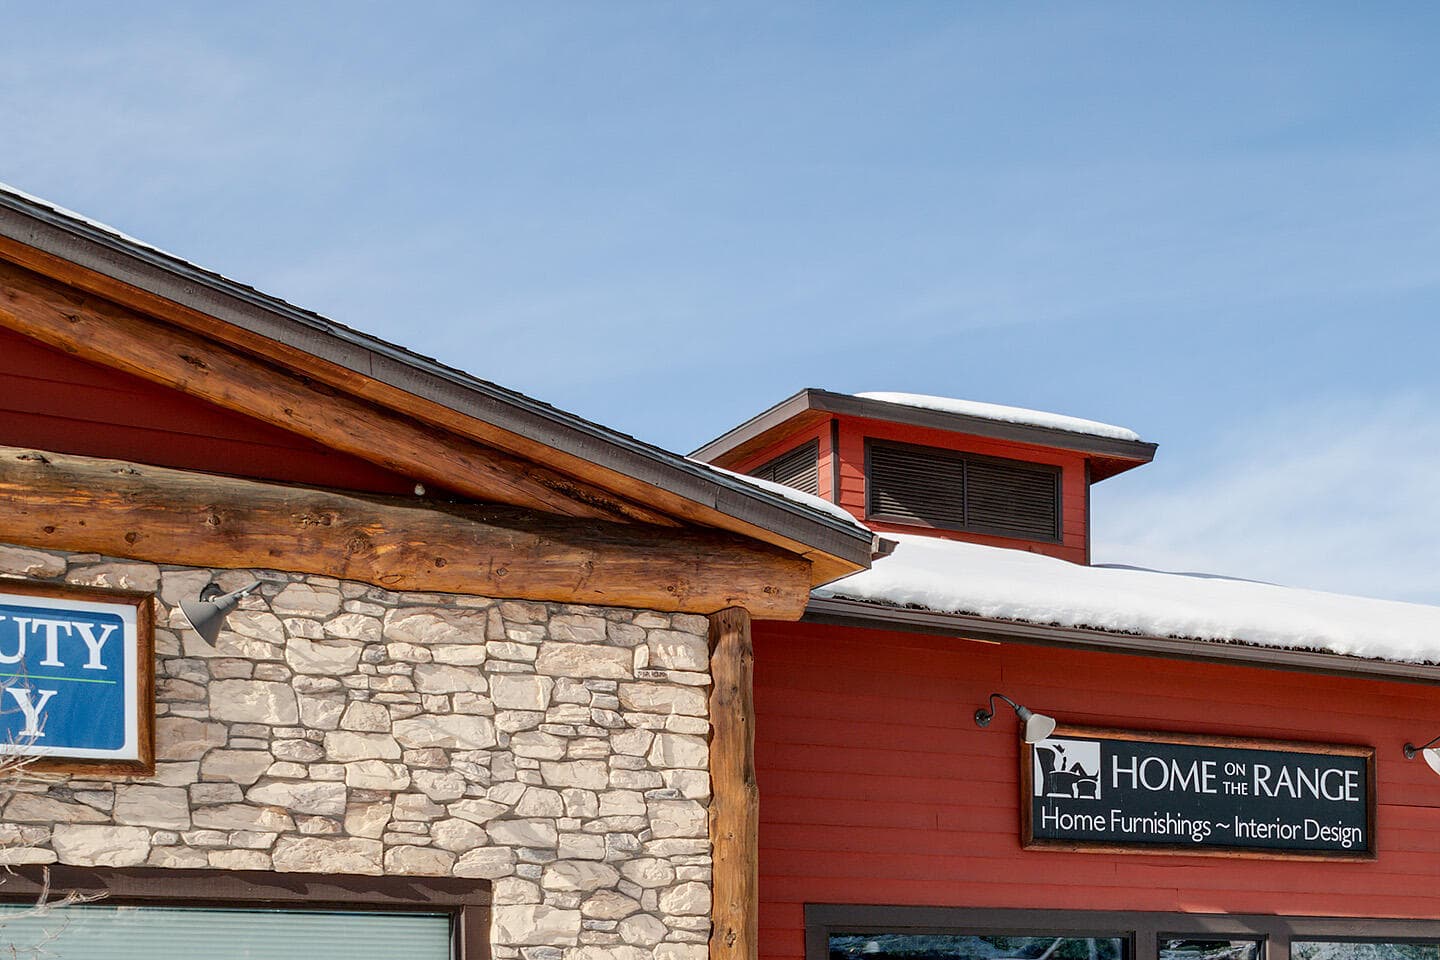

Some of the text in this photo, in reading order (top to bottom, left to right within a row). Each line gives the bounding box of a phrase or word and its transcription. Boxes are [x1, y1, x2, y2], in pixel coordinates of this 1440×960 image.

[0, 616, 119, 670] UTY
[6, 687, 58, 737] Y
[1112, 755, 1359, 801] HOME ON THE RANGE
[1041, 806, 1106, 832] Home
[1111, 809, 1211, 842] Furnishings
[1235, 815, 1302, 840] Interior
[1304, 819, 1362, 848] Design
